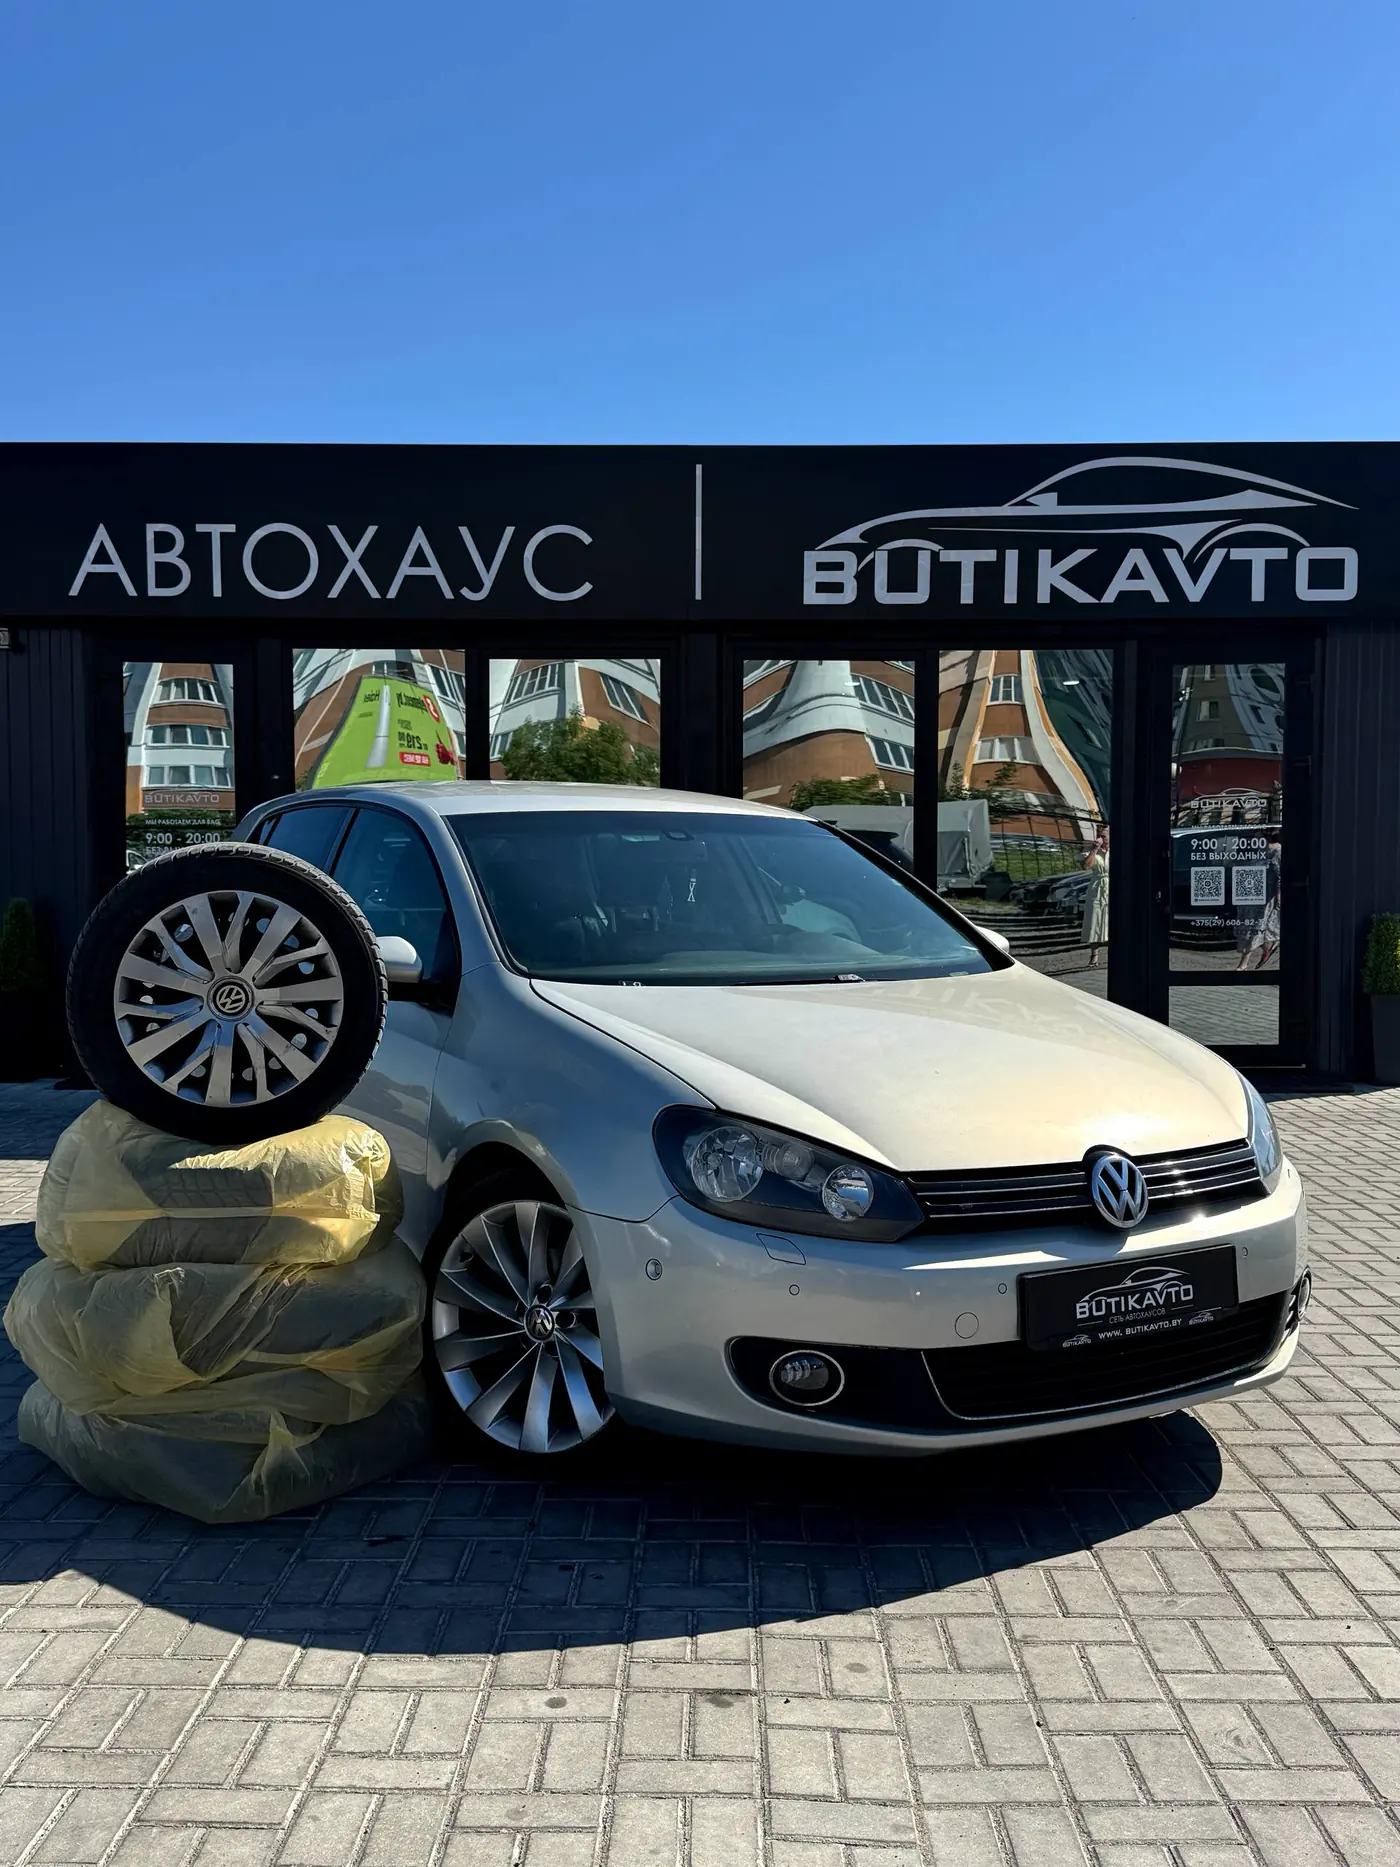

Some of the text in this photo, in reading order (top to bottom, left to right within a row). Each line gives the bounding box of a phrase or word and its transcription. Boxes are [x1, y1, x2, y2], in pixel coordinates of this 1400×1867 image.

[68, 522, 594, 601] АВТОХАУС
[803, 547, 1358, 605] BUTIKAVTO
[145, 795, 219, 803] BUTIKAVTO
[1191, 799, 1267, 808] BUTIKAVTO
[146, 832, 173, 844] 9:00
[185, 832, 220, 844] 20:00
[1191, 838, 1218, 849] 9:00
[1232, 837, 1267, 849] 20:00
[1191, 852, 1266, 860] БЕЗ ВЫХОДНЫХ
[1076, 1284, 1194, 1319] BUTIKAVTO
[1108, 1307, 1166, 1324] СЕТЬ АВТОХАУСОВ
[1098, 1318, 1182, 1339] WWW. BUTIKAVTO.BY
